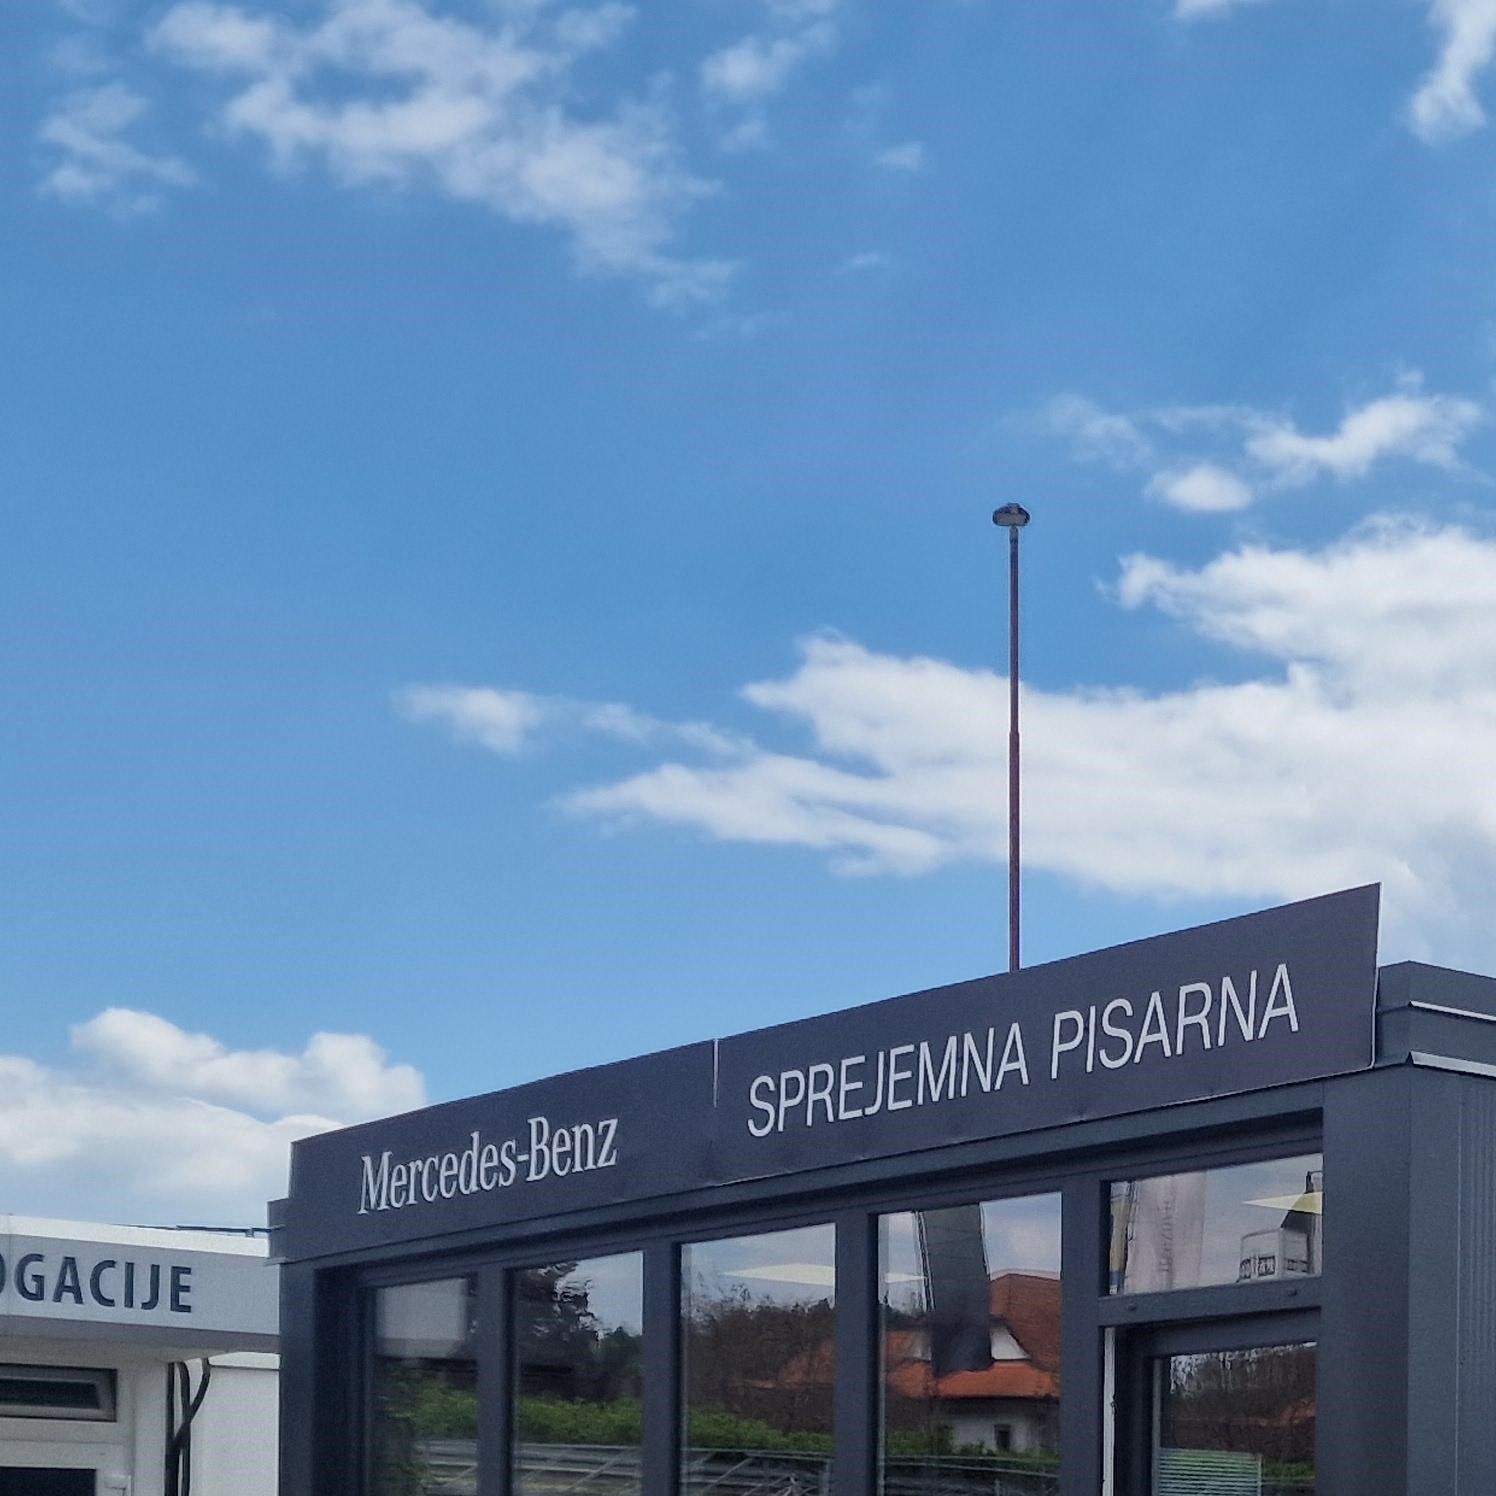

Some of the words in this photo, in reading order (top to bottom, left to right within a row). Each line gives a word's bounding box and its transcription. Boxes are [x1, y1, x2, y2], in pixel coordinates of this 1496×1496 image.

[747, 1022, 1030, 1137] SPREJEMNA
[1050, 963, 1299, 1079] PISARNA
[357, 1115, 619, 1215] Mercedes-Benz
[0, 1252, 192, 1313] GACIJE
